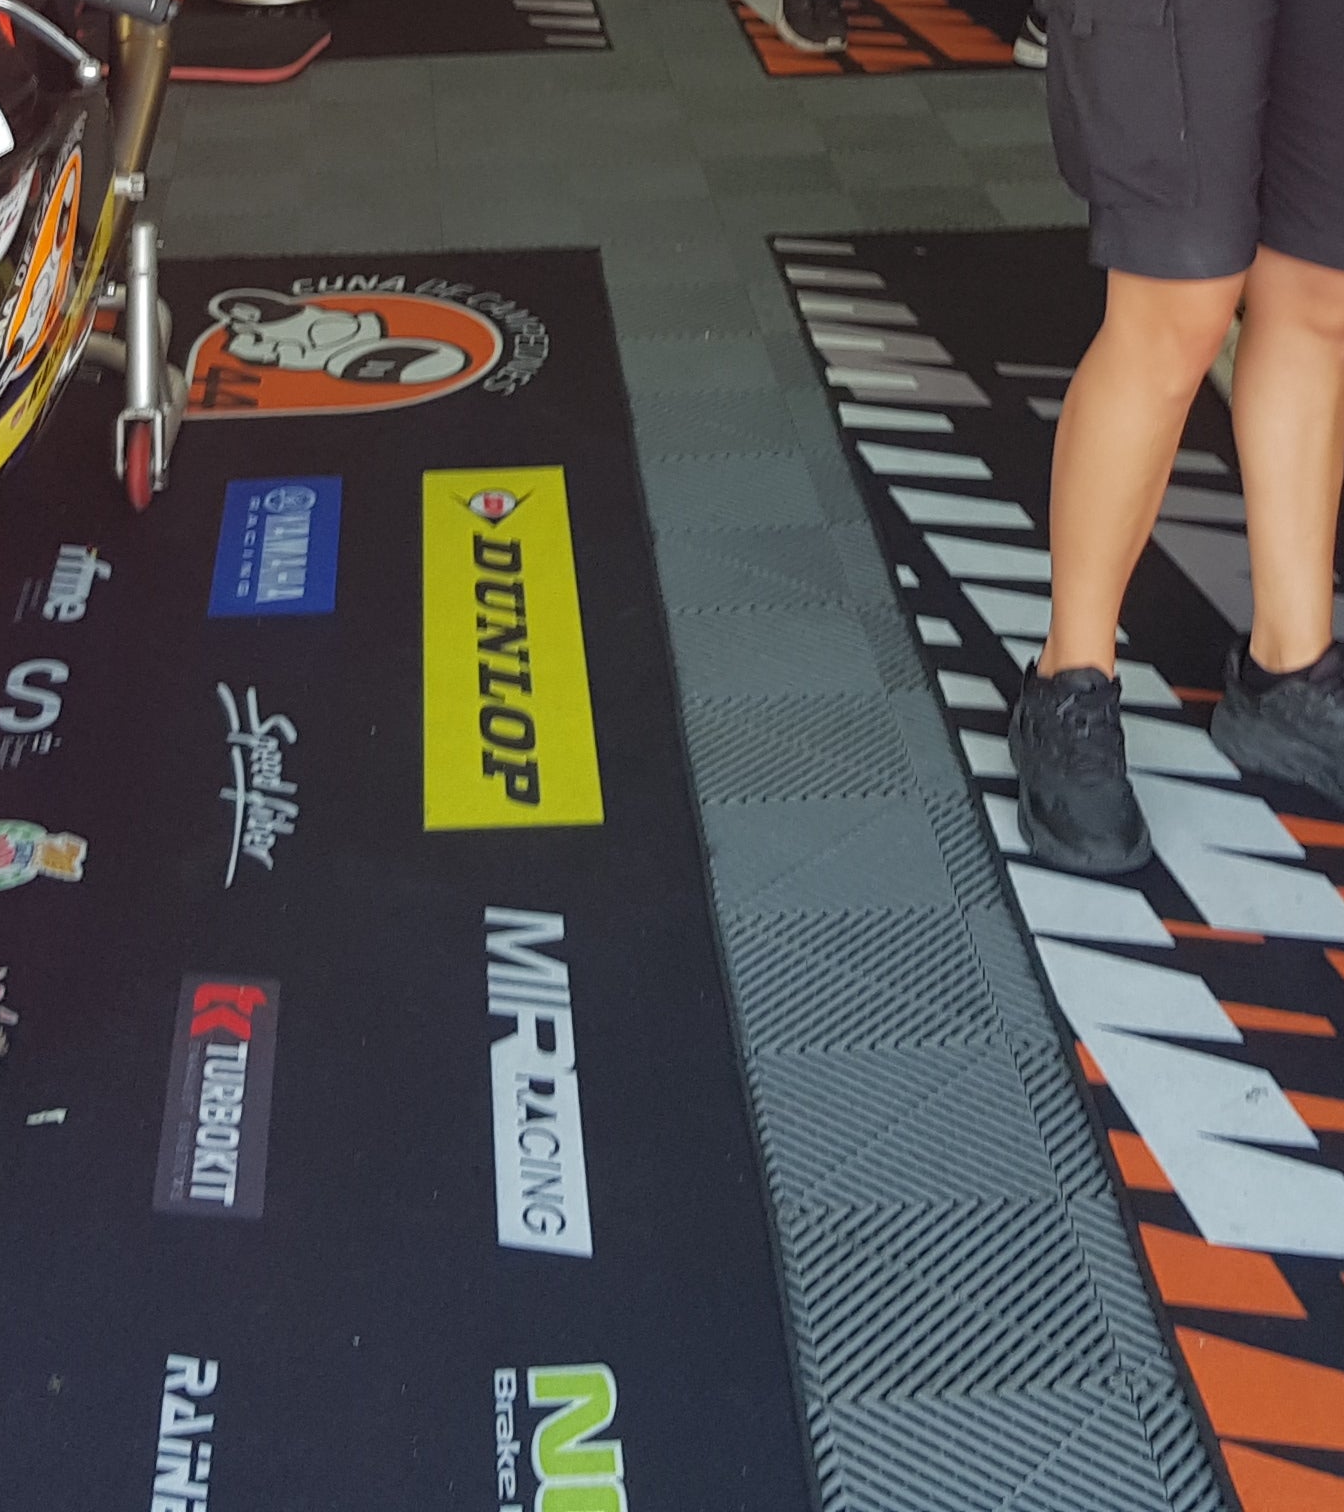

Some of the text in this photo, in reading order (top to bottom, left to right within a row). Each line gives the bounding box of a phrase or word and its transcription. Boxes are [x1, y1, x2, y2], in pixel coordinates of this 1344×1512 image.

[292, 274, 407, 294] CUNA
[472, 532, 542, 808] DUNLOP
[190, 1039, 249, 1209] TURBOKIT
[483, 904, 577, 1237] MIR RACING
[493, 1366, 518, 1500] Brake
